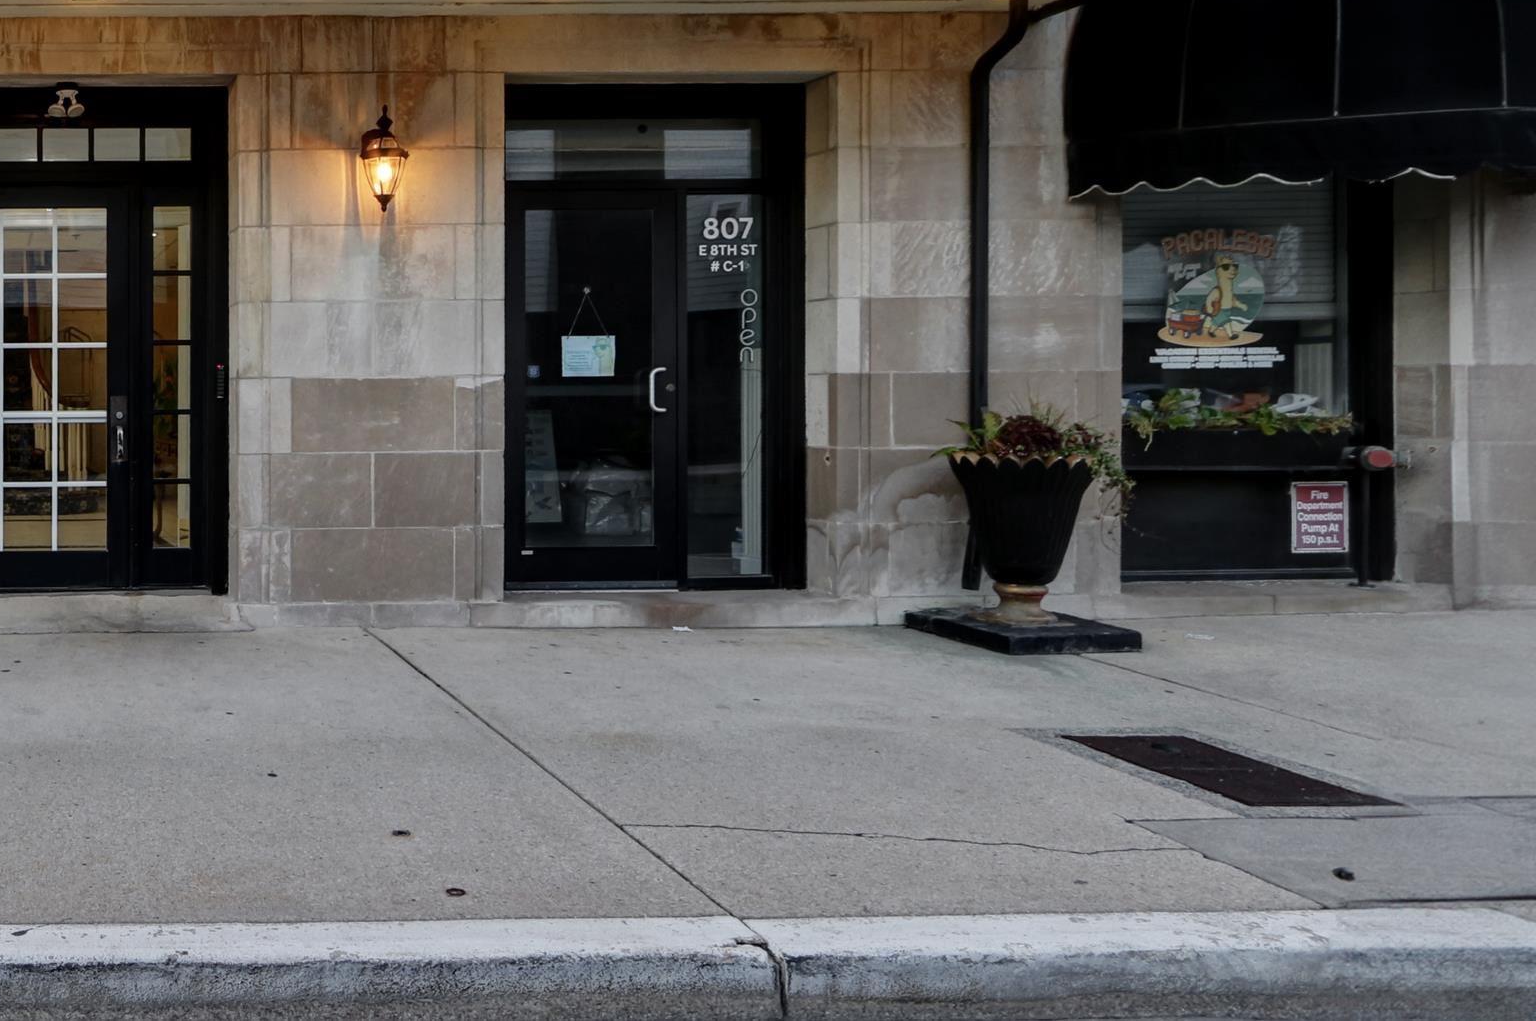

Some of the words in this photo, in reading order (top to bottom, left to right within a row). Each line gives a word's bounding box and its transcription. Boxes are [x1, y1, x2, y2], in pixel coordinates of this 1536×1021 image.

[702, 216, 755, 240] 807
[698, 244, 708, 257] E
[710, 244, 738, 257] 8TH
[740, 243, 758, 256] ST
[710, 260, 721, 272] #
[723, 260, 745, 272] C-1
[1311, 490, 1329, 499] Fire
[1296, 501, 1343, 511] Department
[1297, 512, 1343, 521] Connection
[1301, 523, 1327, 533] Pump
[1329, 523, 1339, 532] At
[1302, 535, 1316, 544] 150
